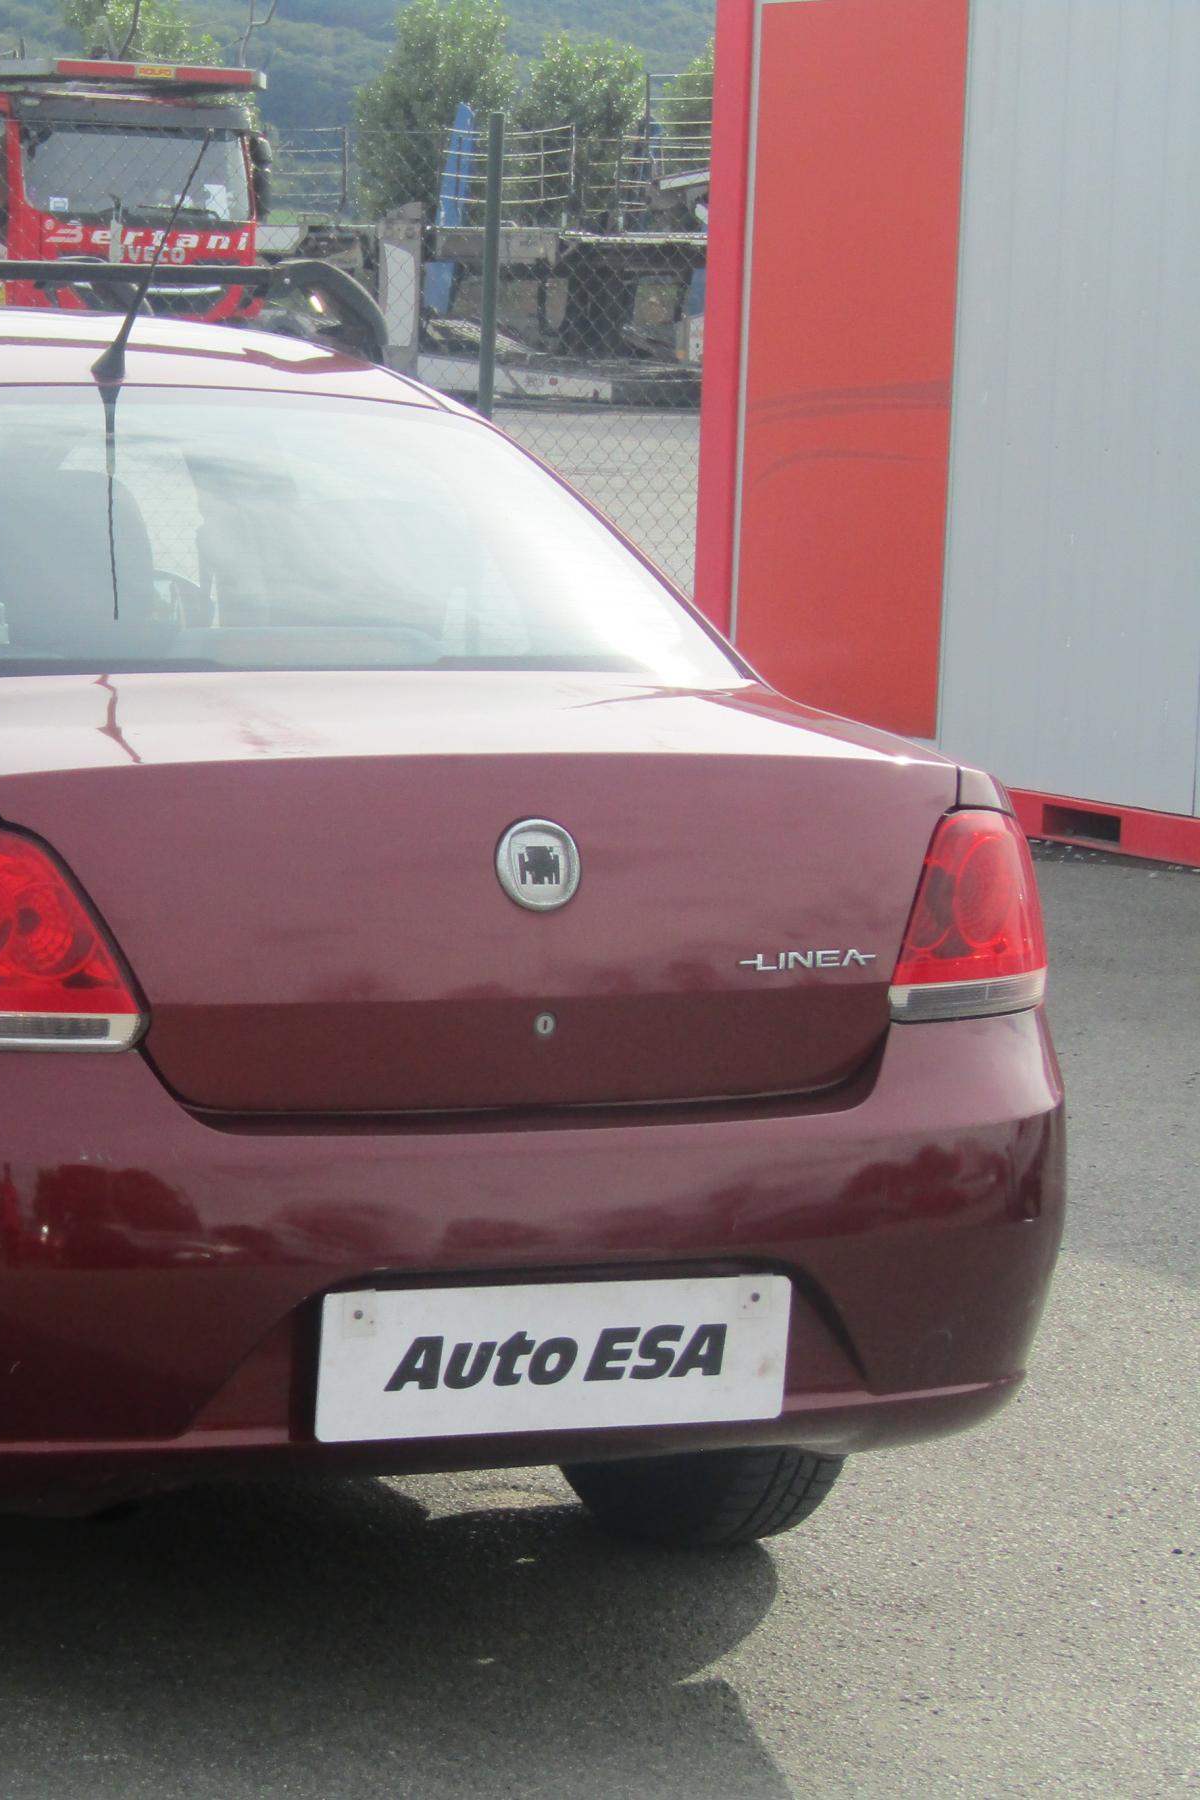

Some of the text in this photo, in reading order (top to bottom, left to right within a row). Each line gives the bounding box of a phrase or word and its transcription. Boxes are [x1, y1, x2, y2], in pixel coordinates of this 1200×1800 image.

[740, 949, 877, 971] LINEA
[384, 1323, 727, 1391] Auto ESA
